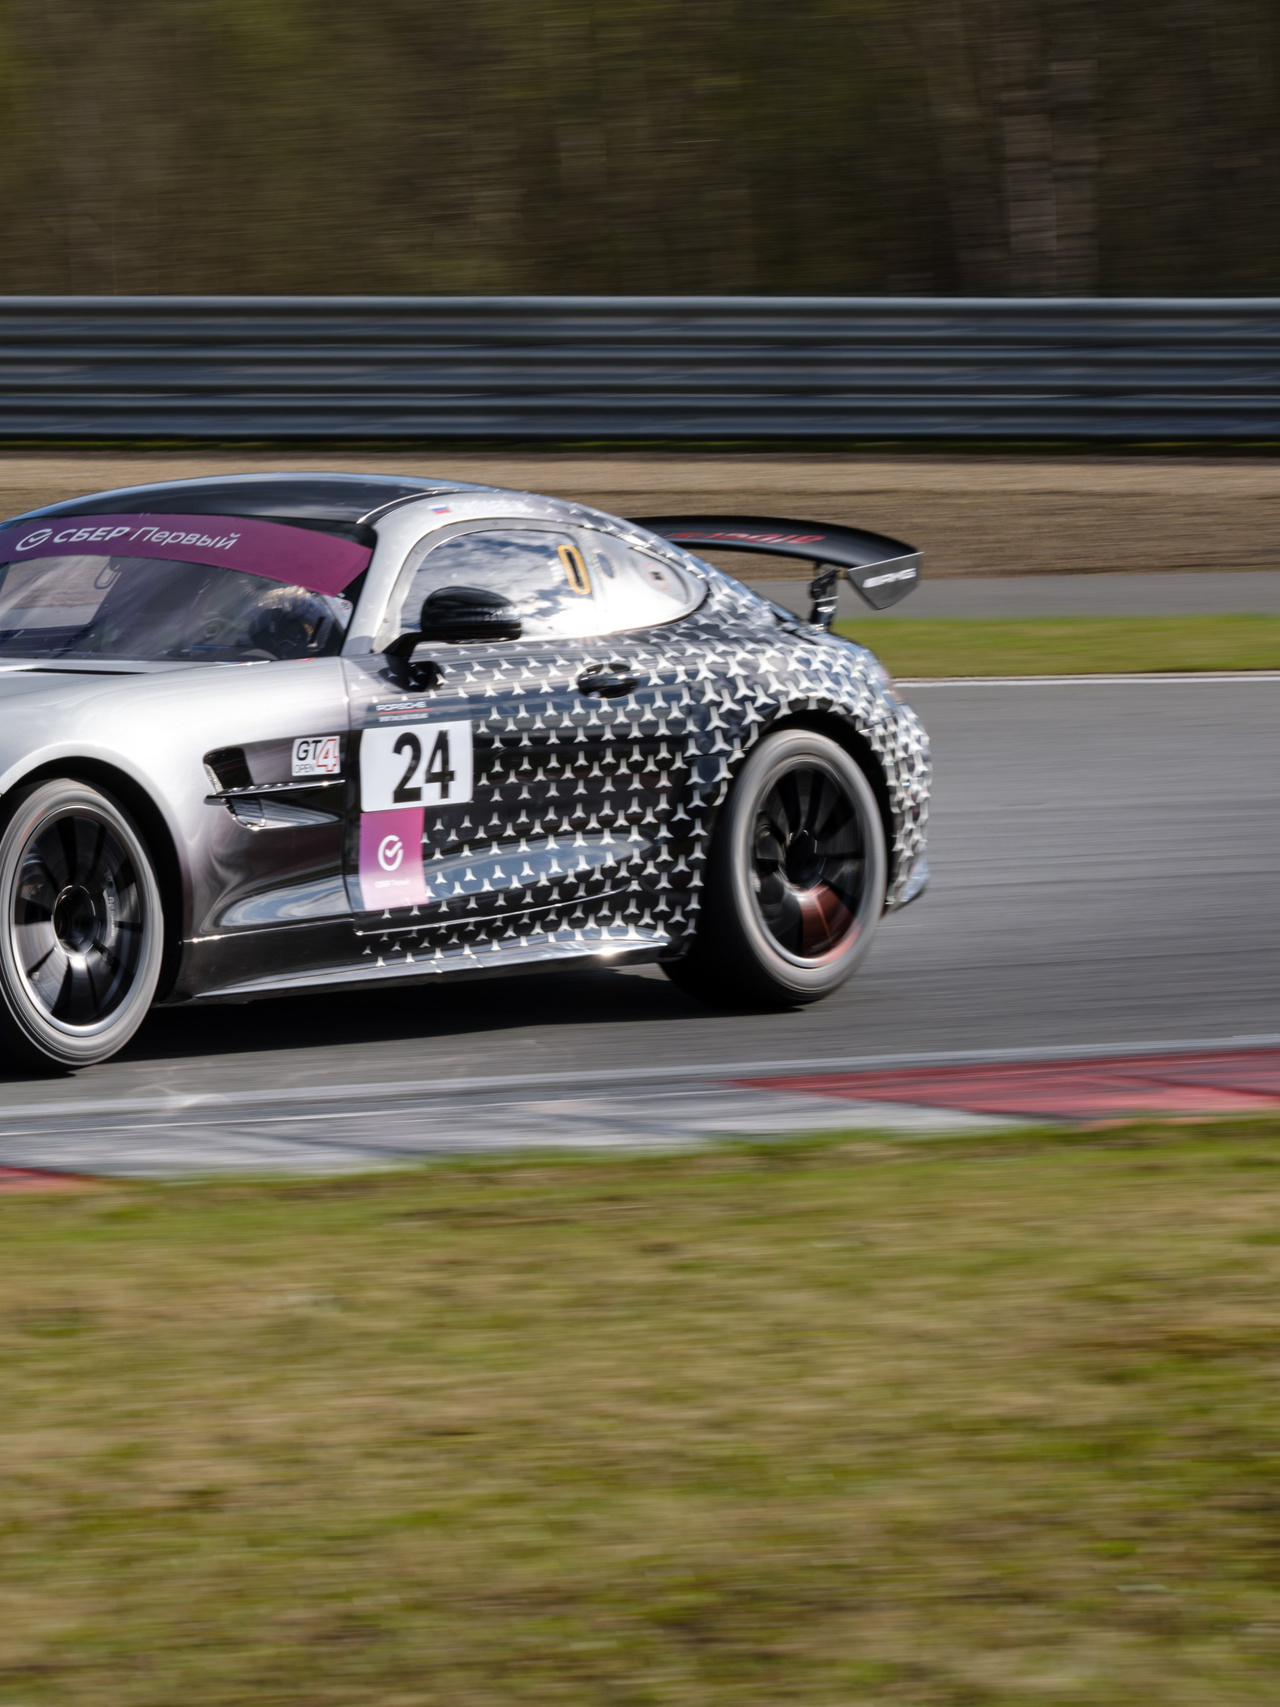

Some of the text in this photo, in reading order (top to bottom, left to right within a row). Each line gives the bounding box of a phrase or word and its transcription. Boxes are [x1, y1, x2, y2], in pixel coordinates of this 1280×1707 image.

[53, 526, 242, 550] СБЕР Первый
[296, 738, 339, 772] GT4
[393, 730, 456, 804] 24
